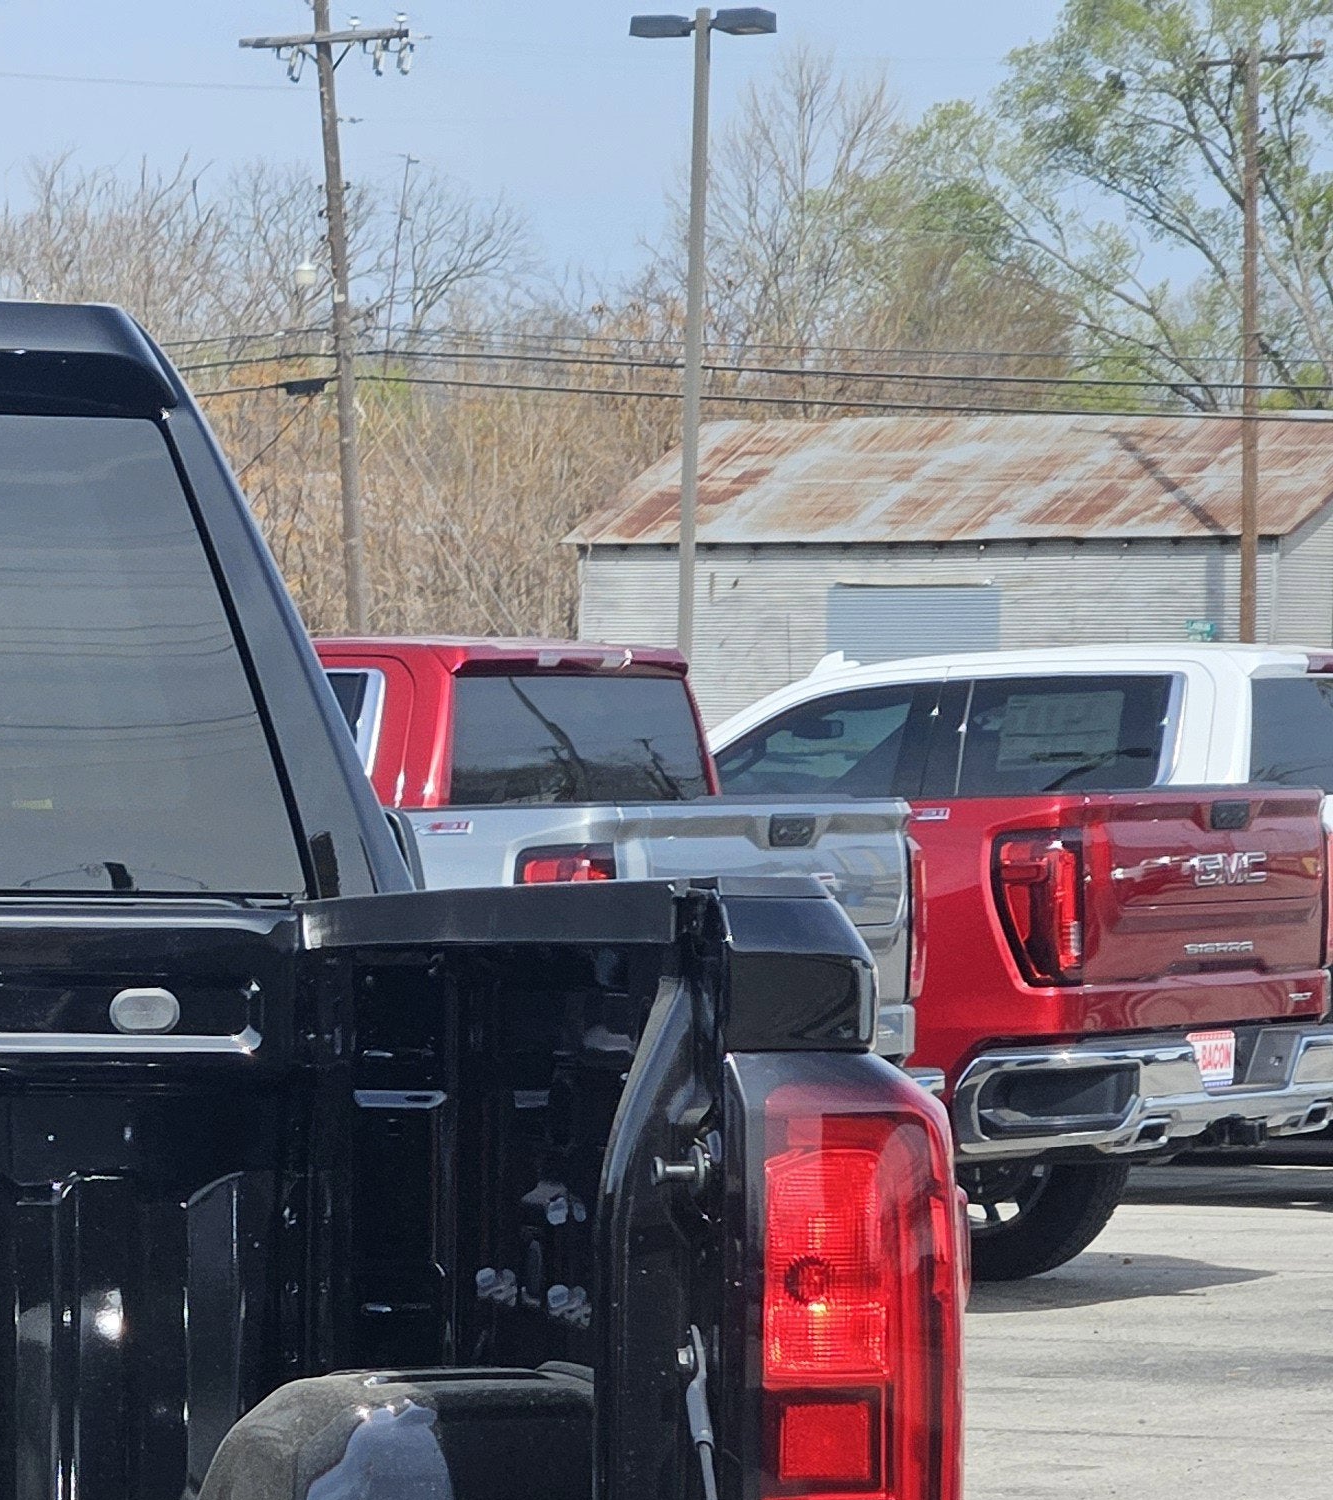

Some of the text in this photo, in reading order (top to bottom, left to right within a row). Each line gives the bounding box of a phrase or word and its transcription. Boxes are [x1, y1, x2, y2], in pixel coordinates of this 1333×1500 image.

[1194, 851, 1268, 887] GMC
[1183, 941, 1253, 955] SIERRA
[1201, 1043, 1232, 1070] BACON
